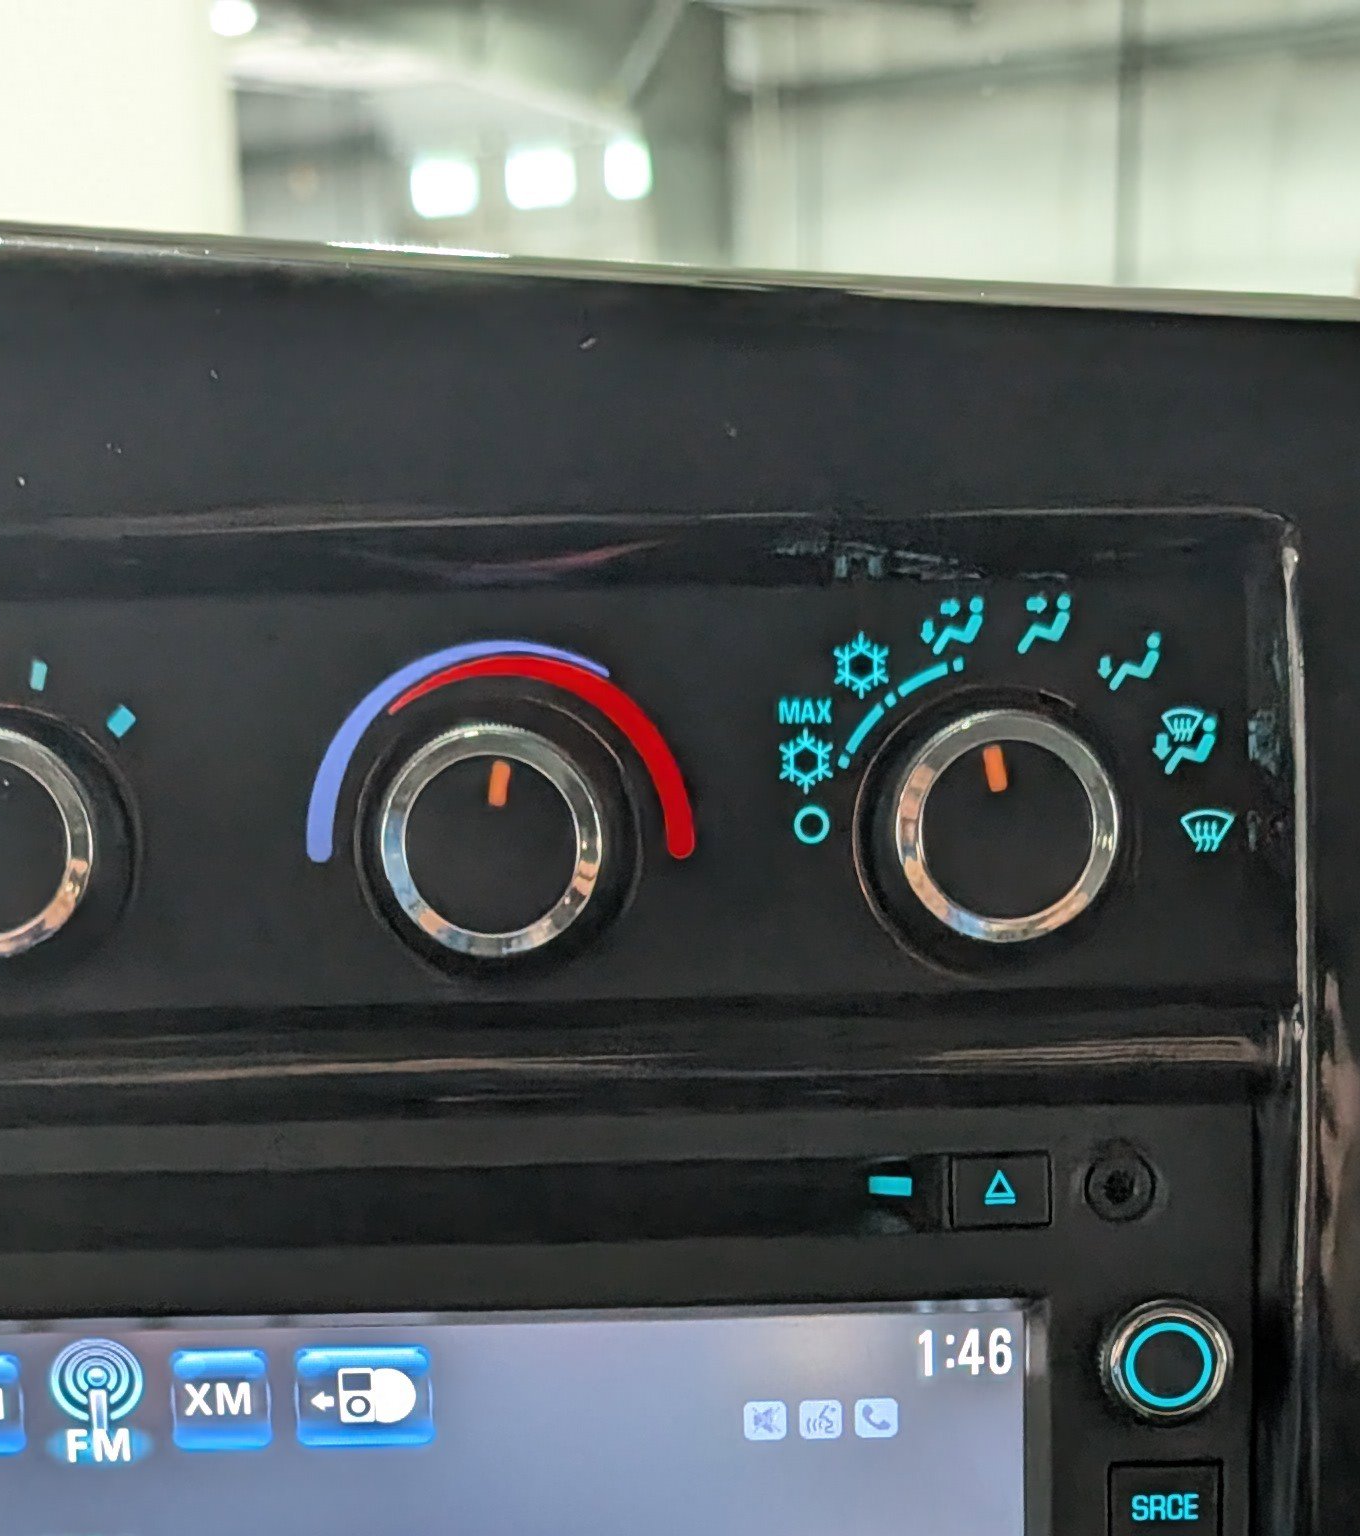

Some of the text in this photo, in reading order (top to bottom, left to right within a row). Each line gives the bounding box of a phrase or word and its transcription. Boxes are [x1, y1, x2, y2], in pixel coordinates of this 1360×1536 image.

[778, 698, 832, 725] MAX
[917, 1327, 1013, 1377] 1:46
[183, 1382, 251, 1416] XM
[65, 1428, 132, 1463] FM
[1131, 1493, 1199, 1521] SRCE
